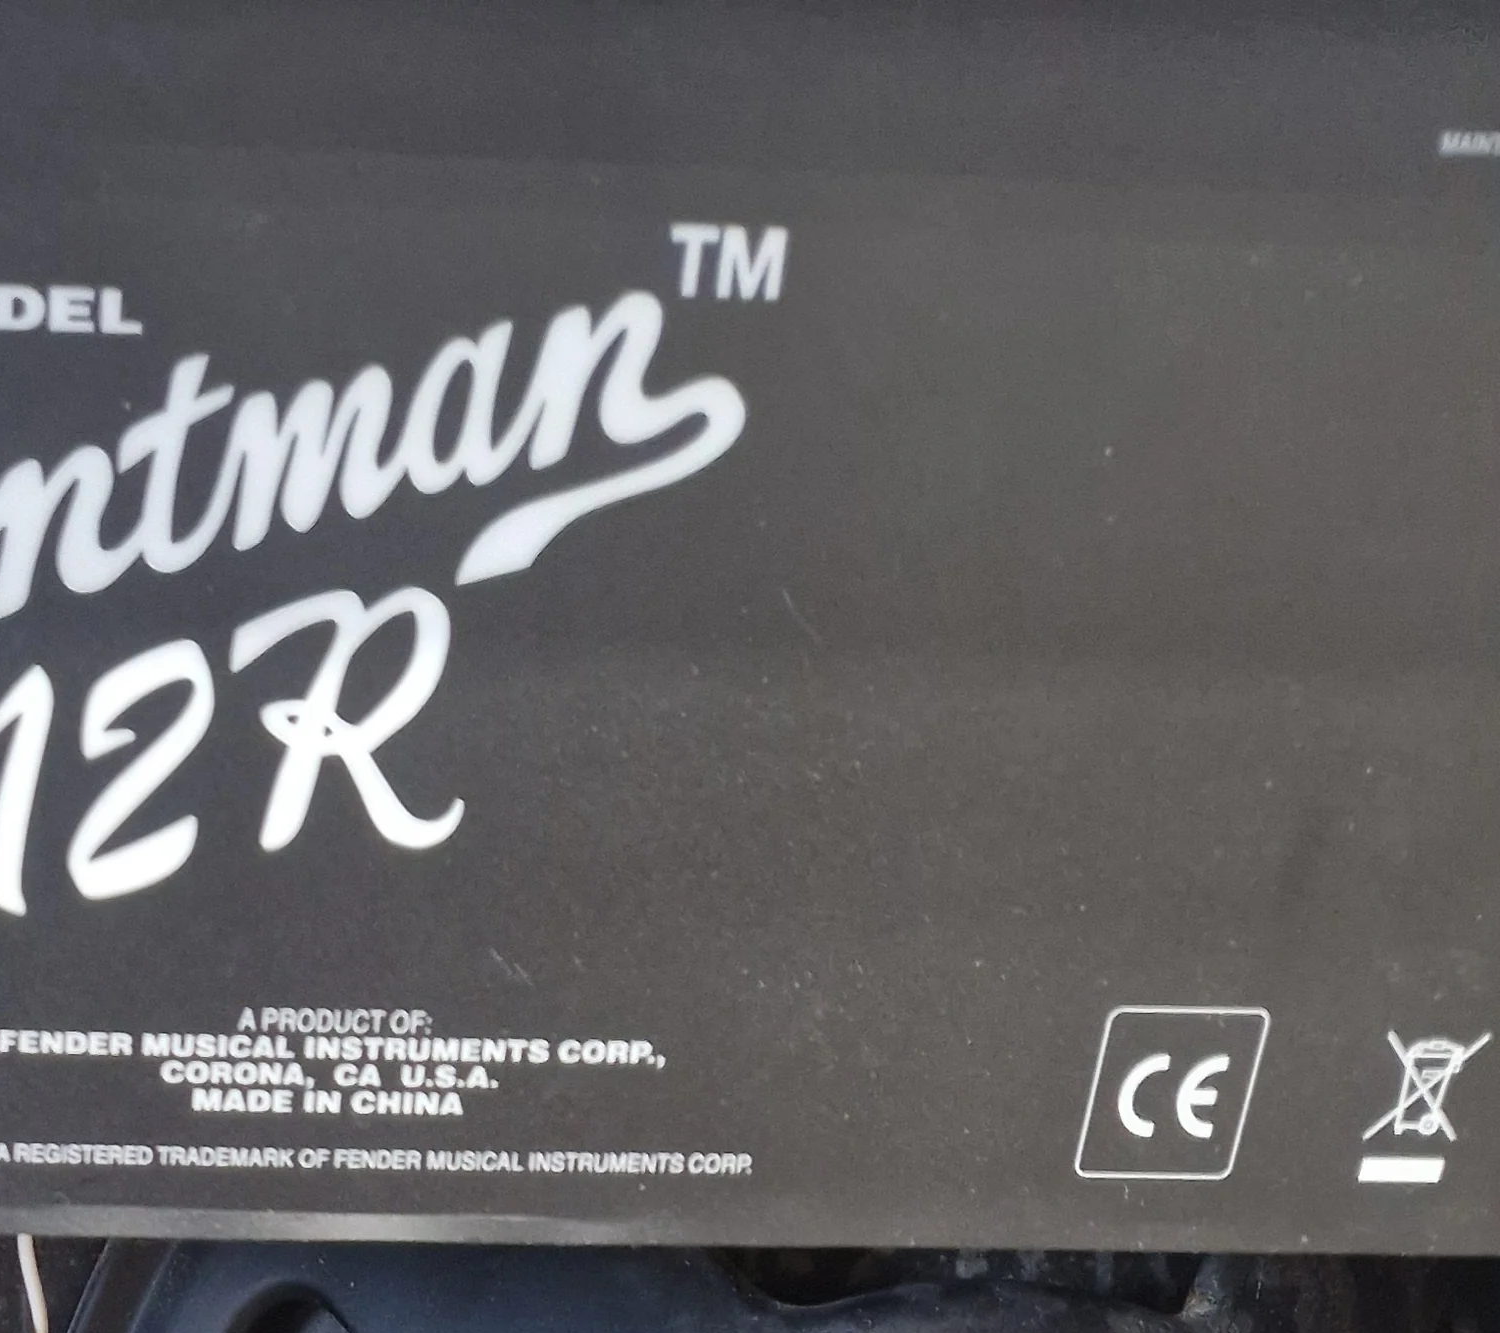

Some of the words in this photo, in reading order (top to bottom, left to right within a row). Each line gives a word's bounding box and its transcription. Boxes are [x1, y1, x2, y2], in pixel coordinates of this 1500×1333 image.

[671, 223, 789, 301] TM
[237, 1006, 257, 1032] A
[260, 1006, 387, 1034] PRODUCT
[388, 1008, 434, 1036] OF:
[140, 1032, 297, 1060] MUSICAL
[302, 1034, 551, 1064] INSTRUMENTS
[158, 1060, 316, 1090] CORONA,
[332, 1062, 383, 1088] CA
[399, 1063, 501, 1090] U.S.A.
[190, 1088, 293, 1114] MADE
[302, 1090, 343, 1115] IN
[349, 1091, 465, 1117] CHINA
[13, 1142, 154, 1167] REGISTERED
[156, 1144, 295, 1169] TRADEMARK
[298, 1147, 331, 1170] OF
[333, 1147, 423, 1171] FENDER
[425, 1149, 525, 1172] MUSICAL
[527, 1150, 686, 1174] INSTRUMENTS
